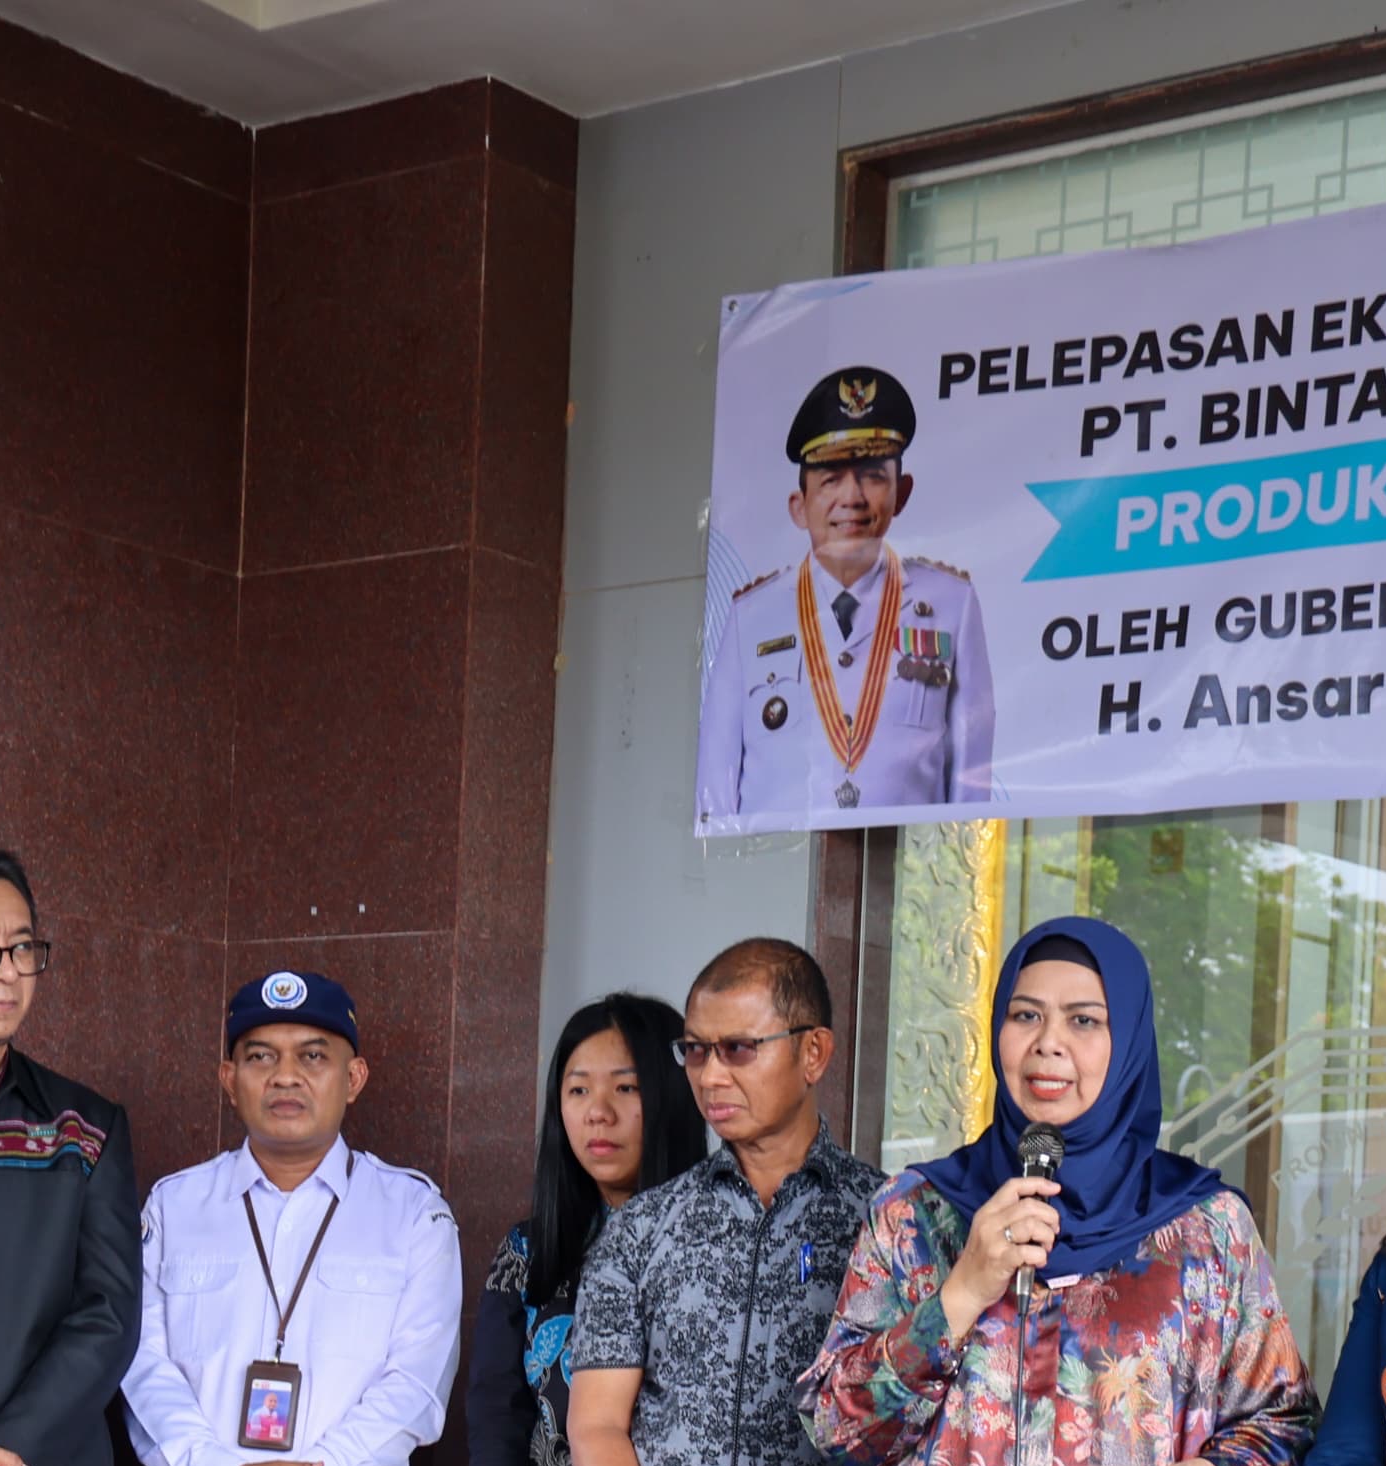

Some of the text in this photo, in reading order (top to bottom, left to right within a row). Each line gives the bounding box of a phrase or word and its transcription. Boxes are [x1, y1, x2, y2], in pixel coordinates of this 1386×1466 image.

[938, 308, 1295, 400] PELEPASAN
[1080, 398, 1177, 458] PT.
[1041, 604, 1190, 661] OLEH
[1098, 681, 1161, 734] H.
[1183, 673, 1385, 729] Ansar
